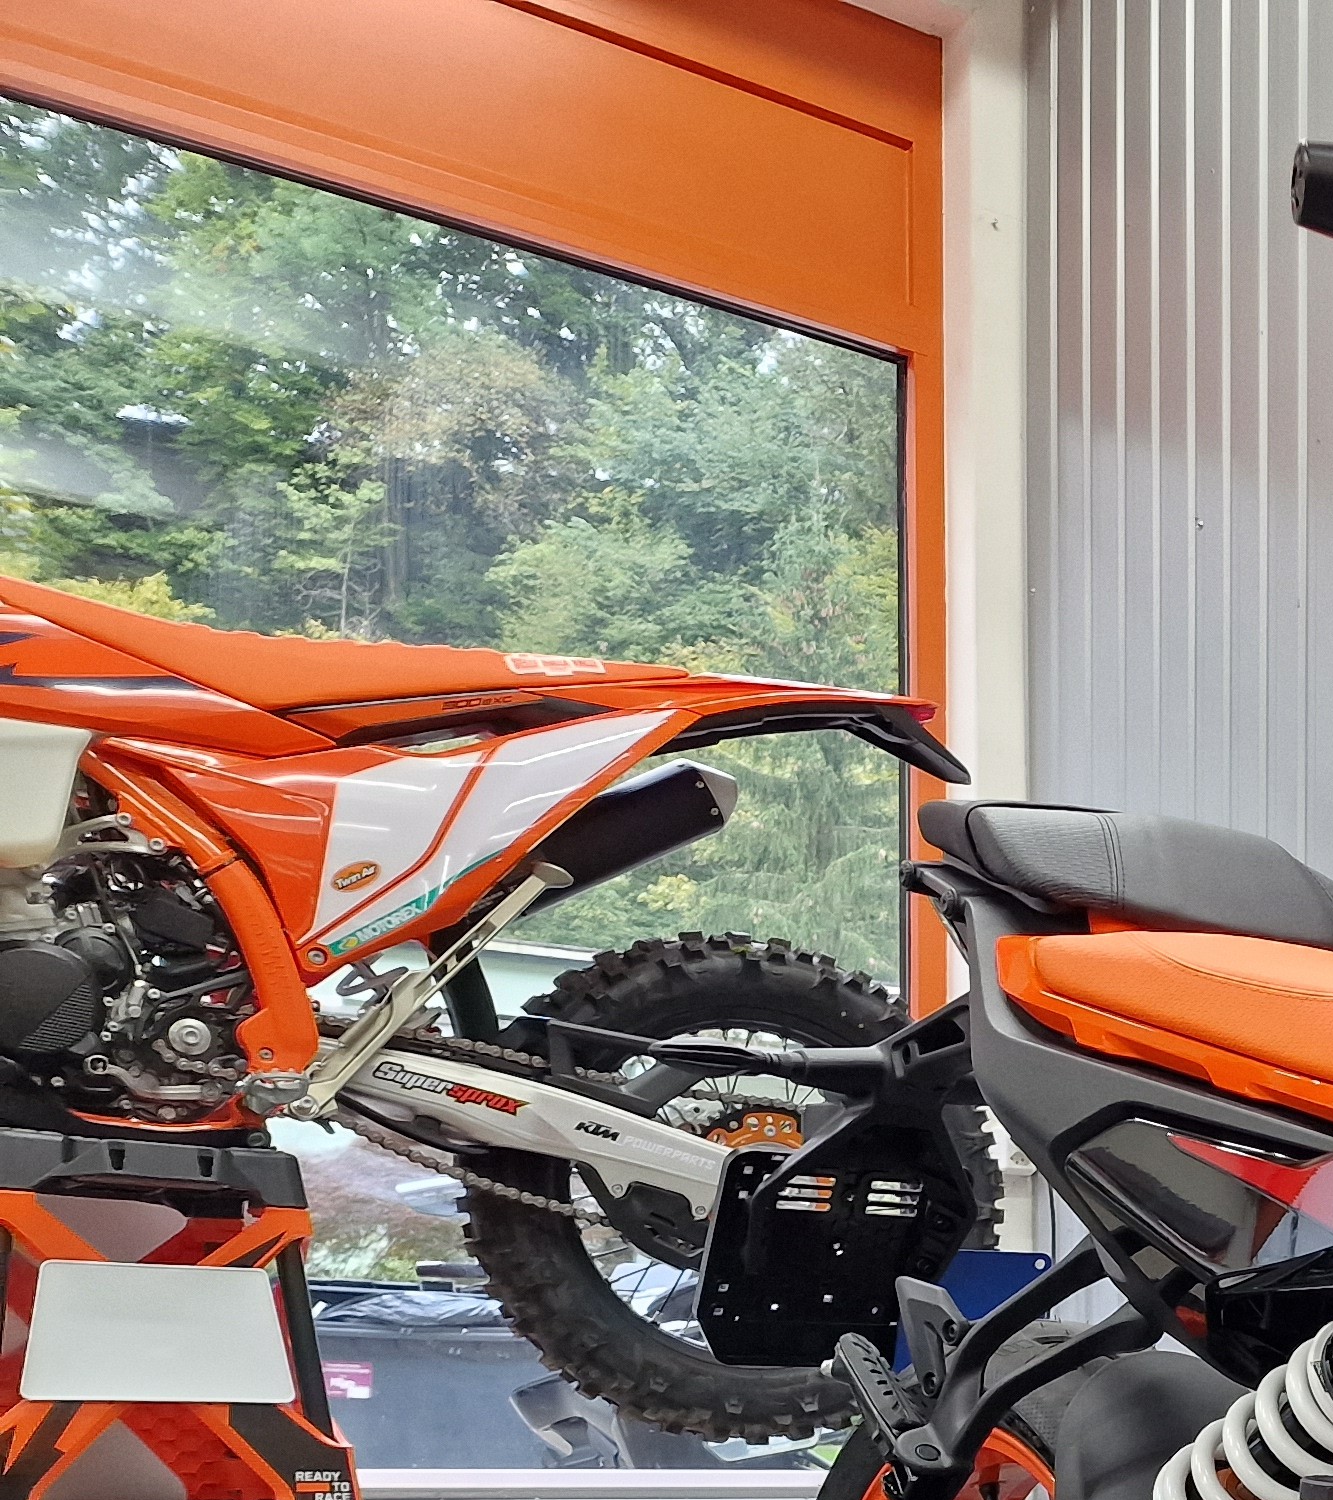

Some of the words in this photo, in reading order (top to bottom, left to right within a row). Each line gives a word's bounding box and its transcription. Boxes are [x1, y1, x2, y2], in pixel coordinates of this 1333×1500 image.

[334, 872, 362, 889] Twin
[361, 864, 377, 878] Air
[356, 902, 423, 941] MOTOREX
[574, 1120, 621, 1143] KTM
[623, 1135, 716, 1171] POWERPARTS
[294, 1470, 342, 1482] READY
[331, 1481, 351, 1492] TO
